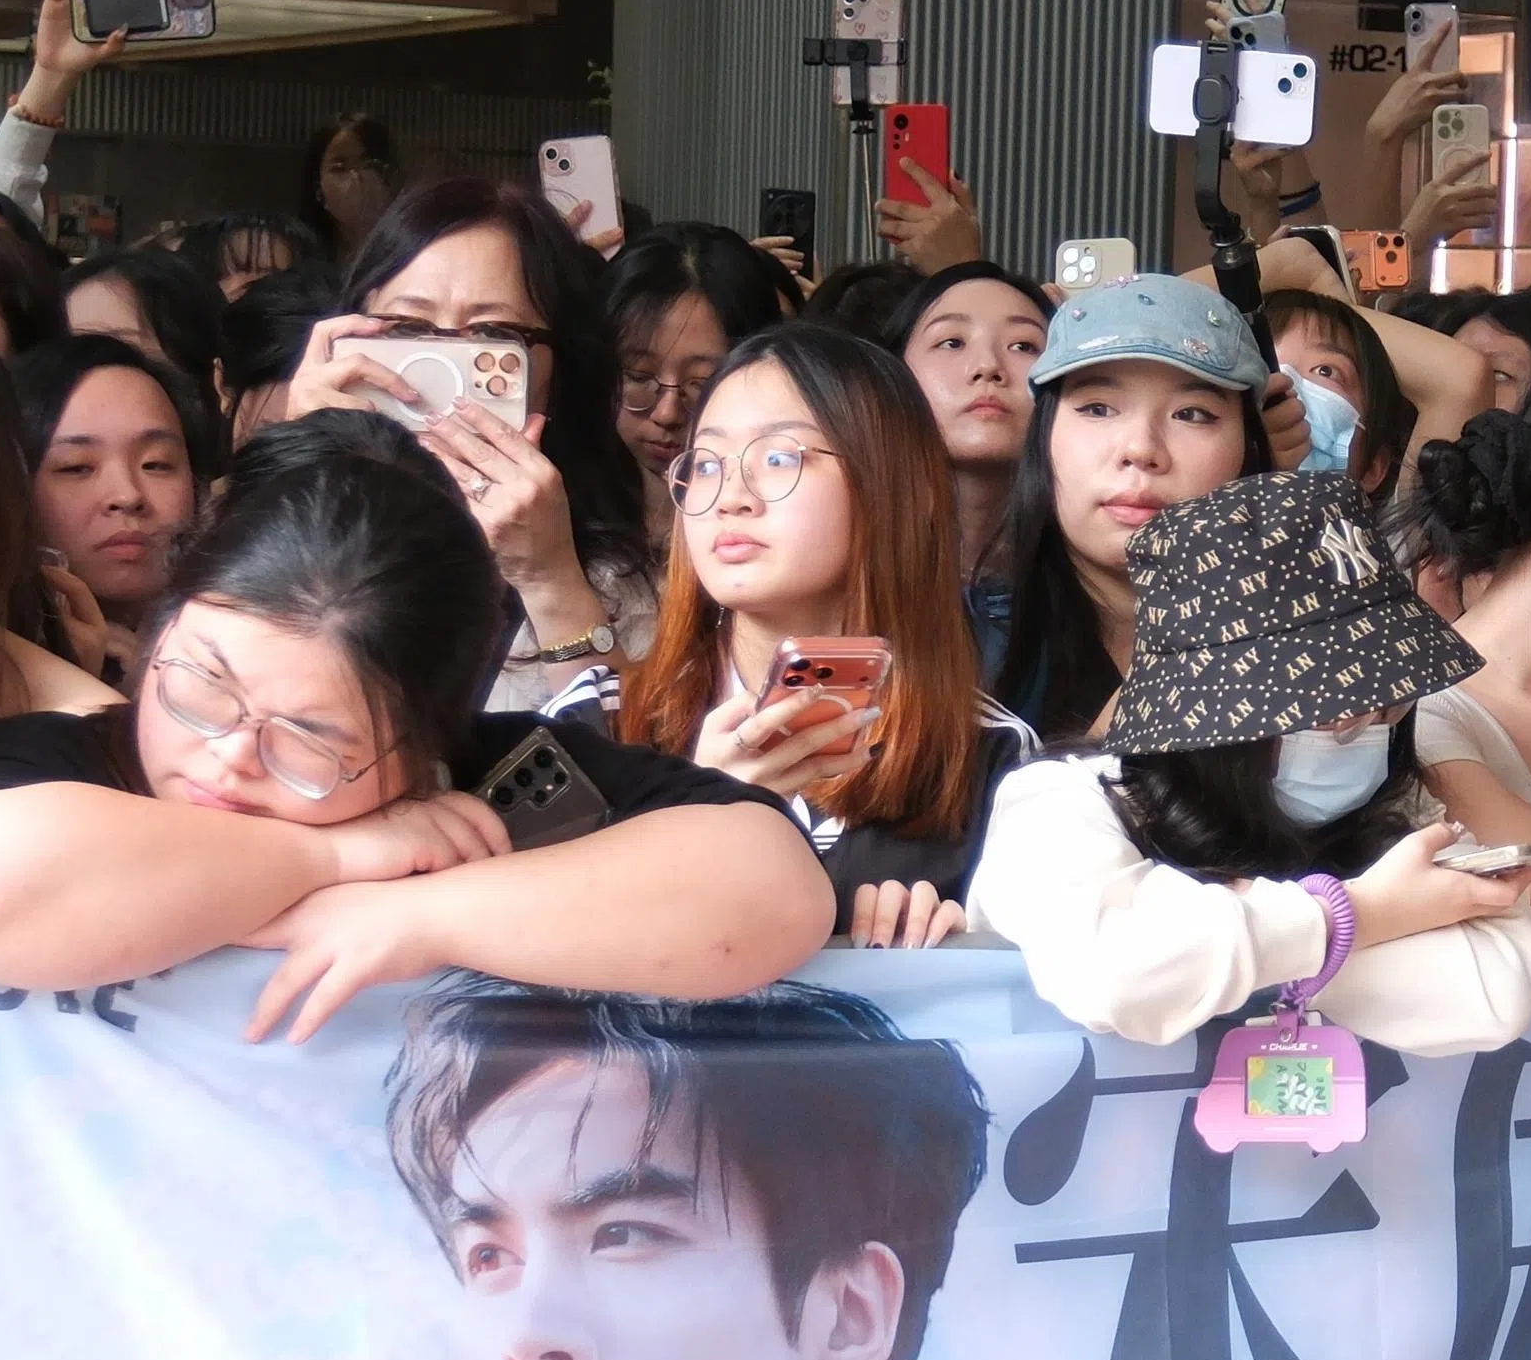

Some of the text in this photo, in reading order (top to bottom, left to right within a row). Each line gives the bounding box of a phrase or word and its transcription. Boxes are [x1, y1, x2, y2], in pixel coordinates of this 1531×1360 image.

[1196, 550, 1222, 574] NY
[1239, 571, 1269, 596] NY
[1147, 607, 1169, 626] NY
[1178, 596, 1202, 620] NY
[1291, 591, 1321, 618] NY
[1221, 618, 1249, 643] NY
[1346, 617, 1377, 642] NY
[1394, 636, 1421, 657] NY
[1190, 648, 1215, 678] NY
[1232, 647, 1261, 677] NY
[1285, 652, 1317, 681] NY
[1335, 662, 1366, 688] NY
[1389, 676, 1418, 700] NY
[1183, 699, 1209, 730] NY
[1228, 697, 1256, 729] NY
[1273, 701, 1305, 732] NY
